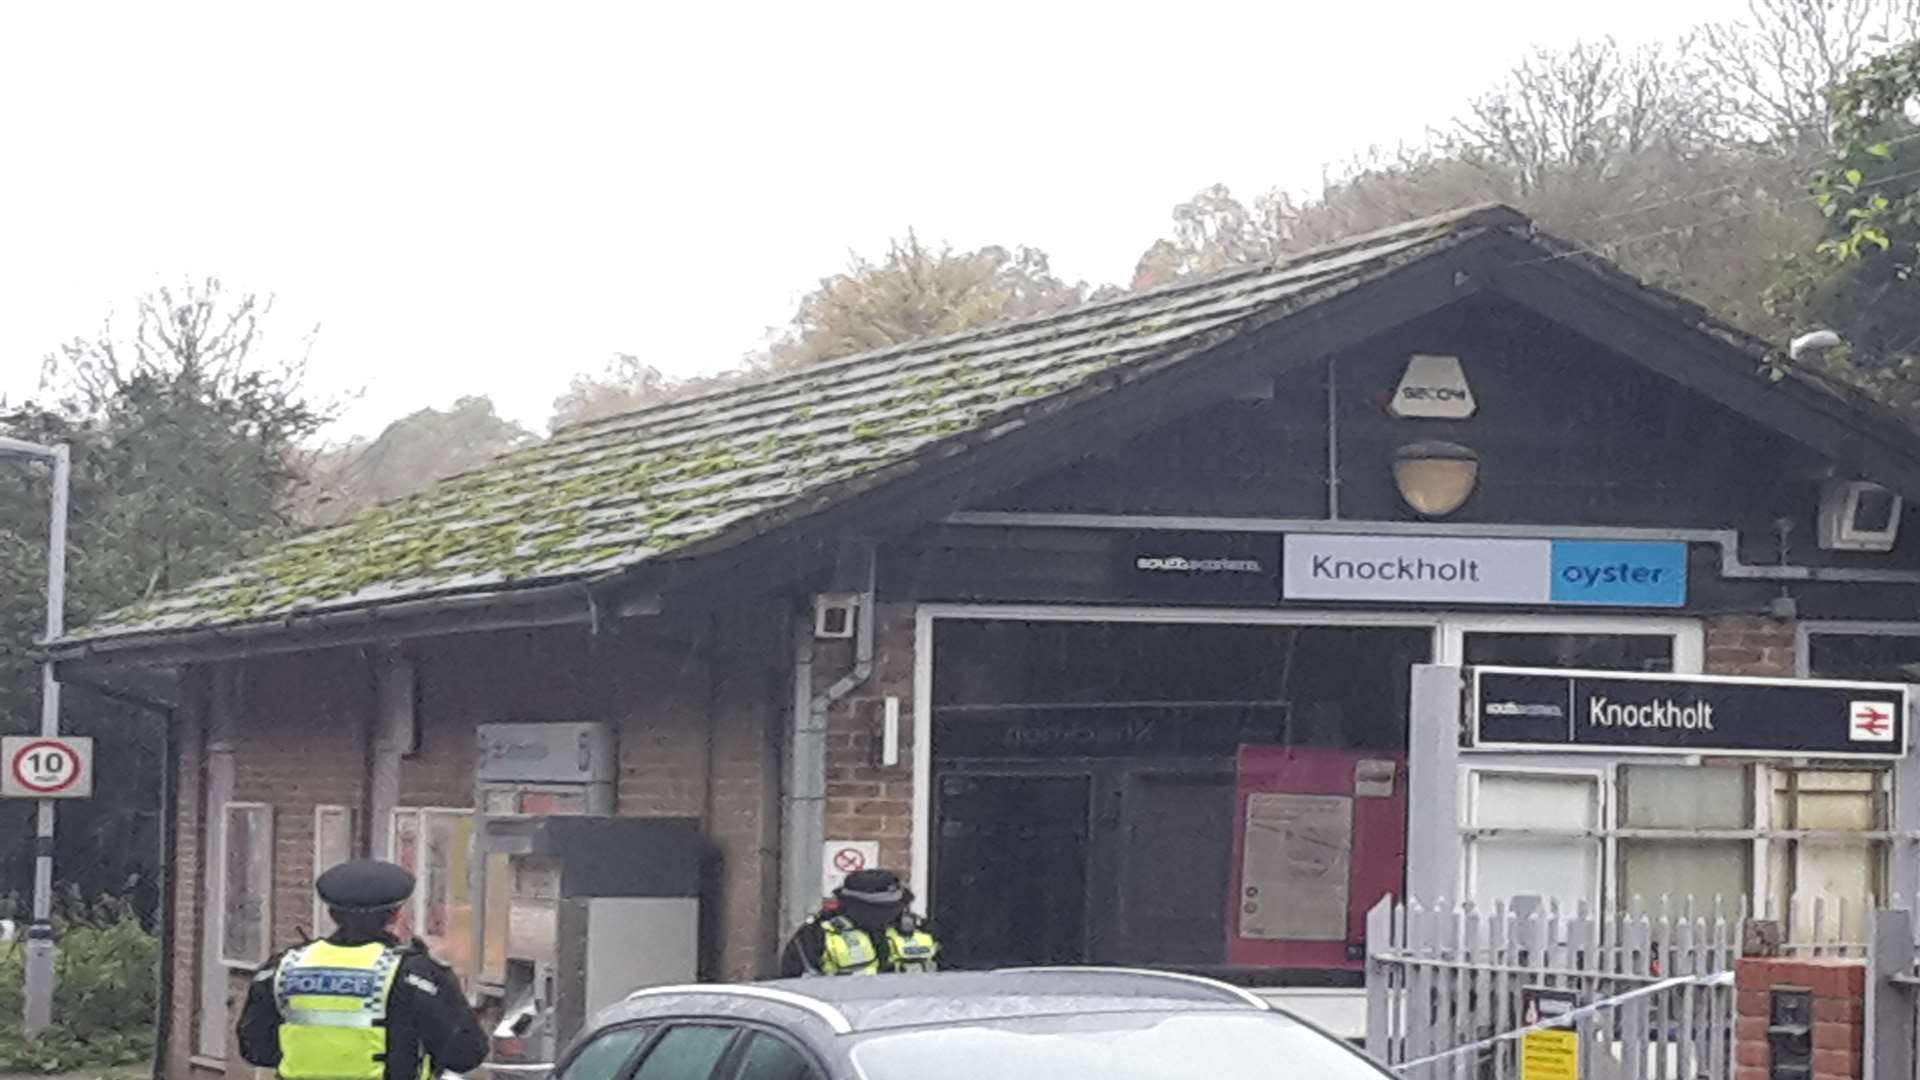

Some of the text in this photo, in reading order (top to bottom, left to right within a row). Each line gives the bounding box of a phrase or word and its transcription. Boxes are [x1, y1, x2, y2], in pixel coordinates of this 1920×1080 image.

[1311, 555, 1481, 583] Knockholt
[1562, 562, 1663, 587] oyster
[1590, 696, 1713, 730] Knockholt
[27, 752, 63, 773] 10
[286, 976, 369, 994] POLICE
